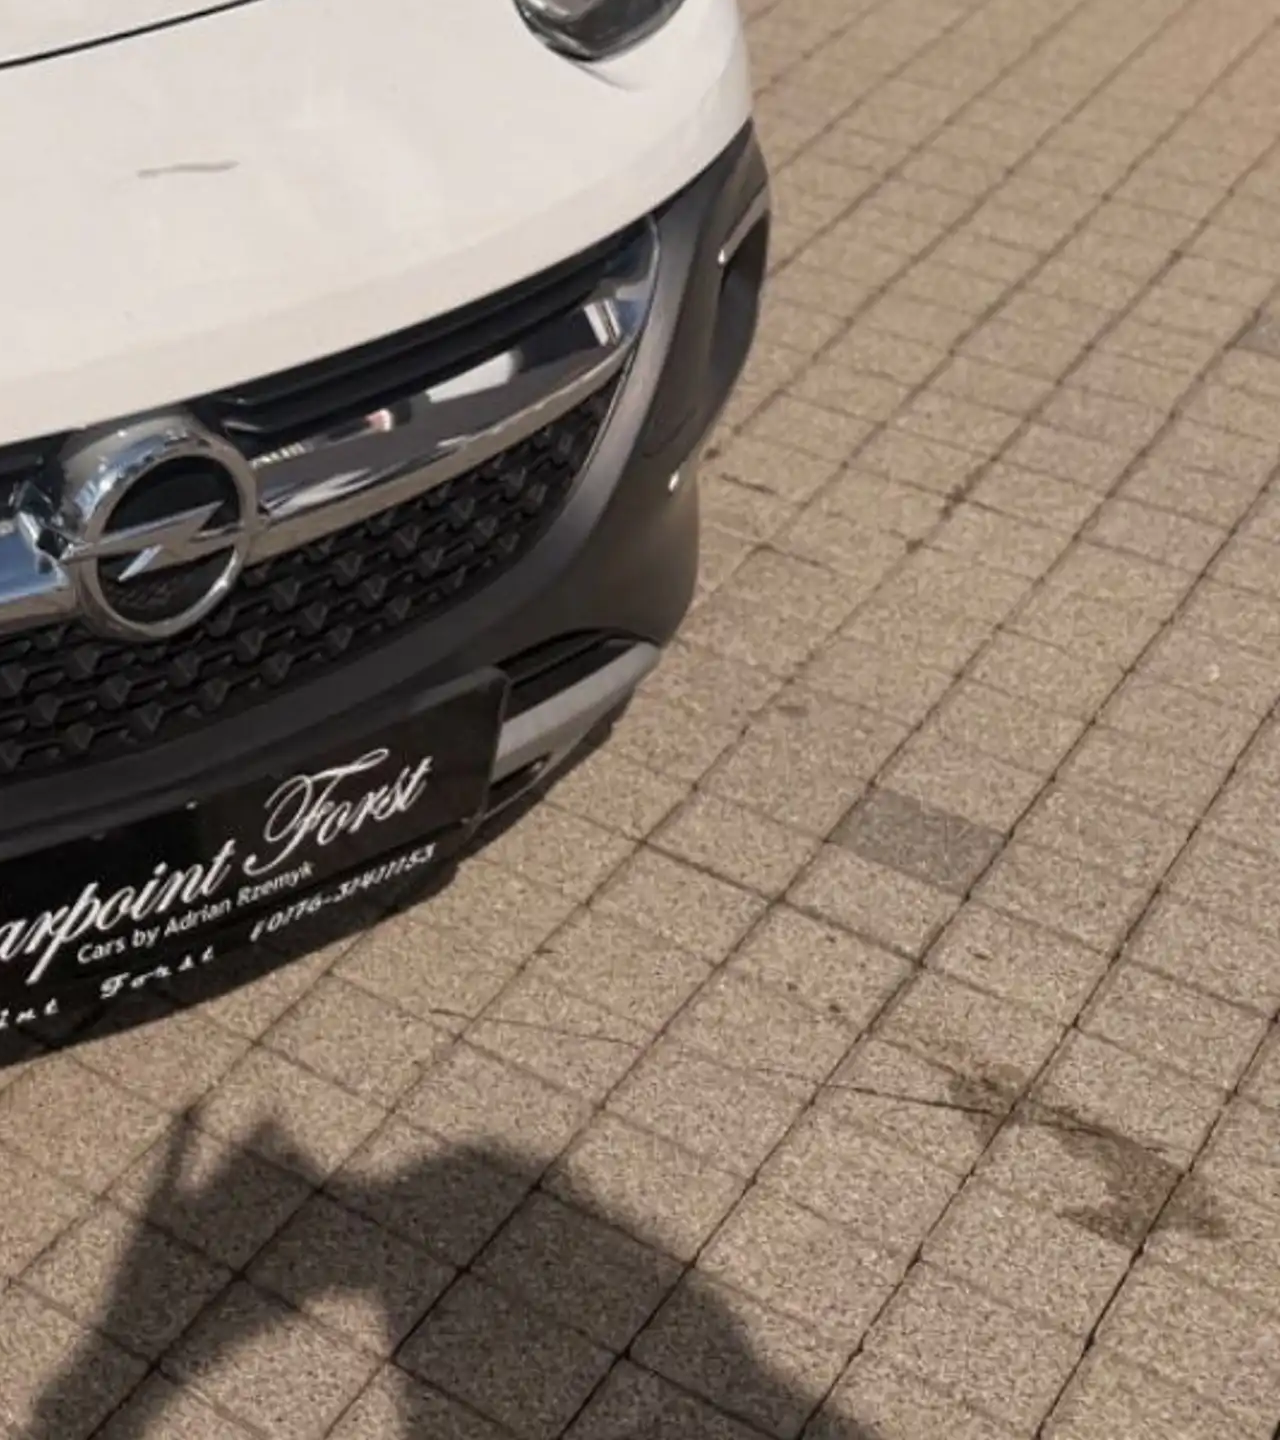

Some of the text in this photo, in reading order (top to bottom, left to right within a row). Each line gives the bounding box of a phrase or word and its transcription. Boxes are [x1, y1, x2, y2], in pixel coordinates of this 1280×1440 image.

[242, 747, 434, 878] Forst
[76, 936, 127, 965] Cars
[130, 922, 162, 950] by
[163, 897, 232, 938] Adrian
